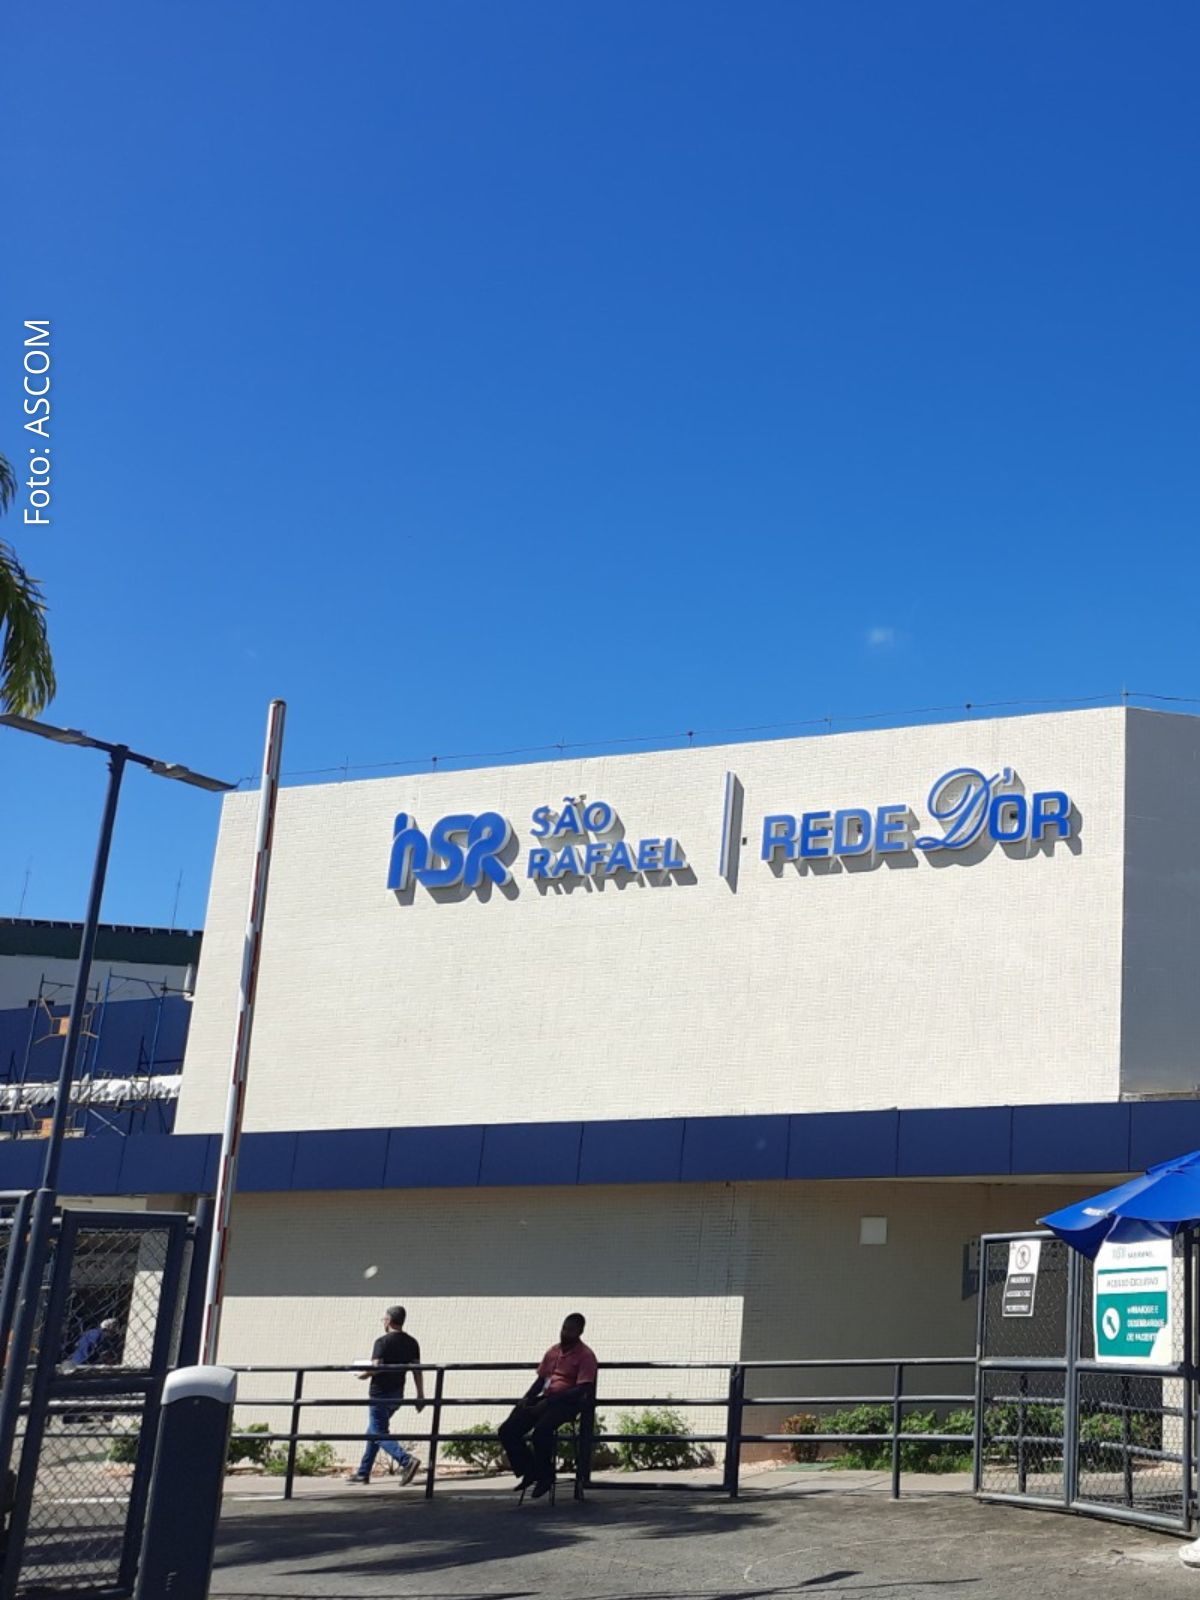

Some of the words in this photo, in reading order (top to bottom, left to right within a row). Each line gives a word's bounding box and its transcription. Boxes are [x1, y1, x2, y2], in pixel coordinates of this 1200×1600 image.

[530, 796, 613, 838] SÃO
[761, 804, 910, 861] REDE
[526, 837, 687, 880] RAFAEL
